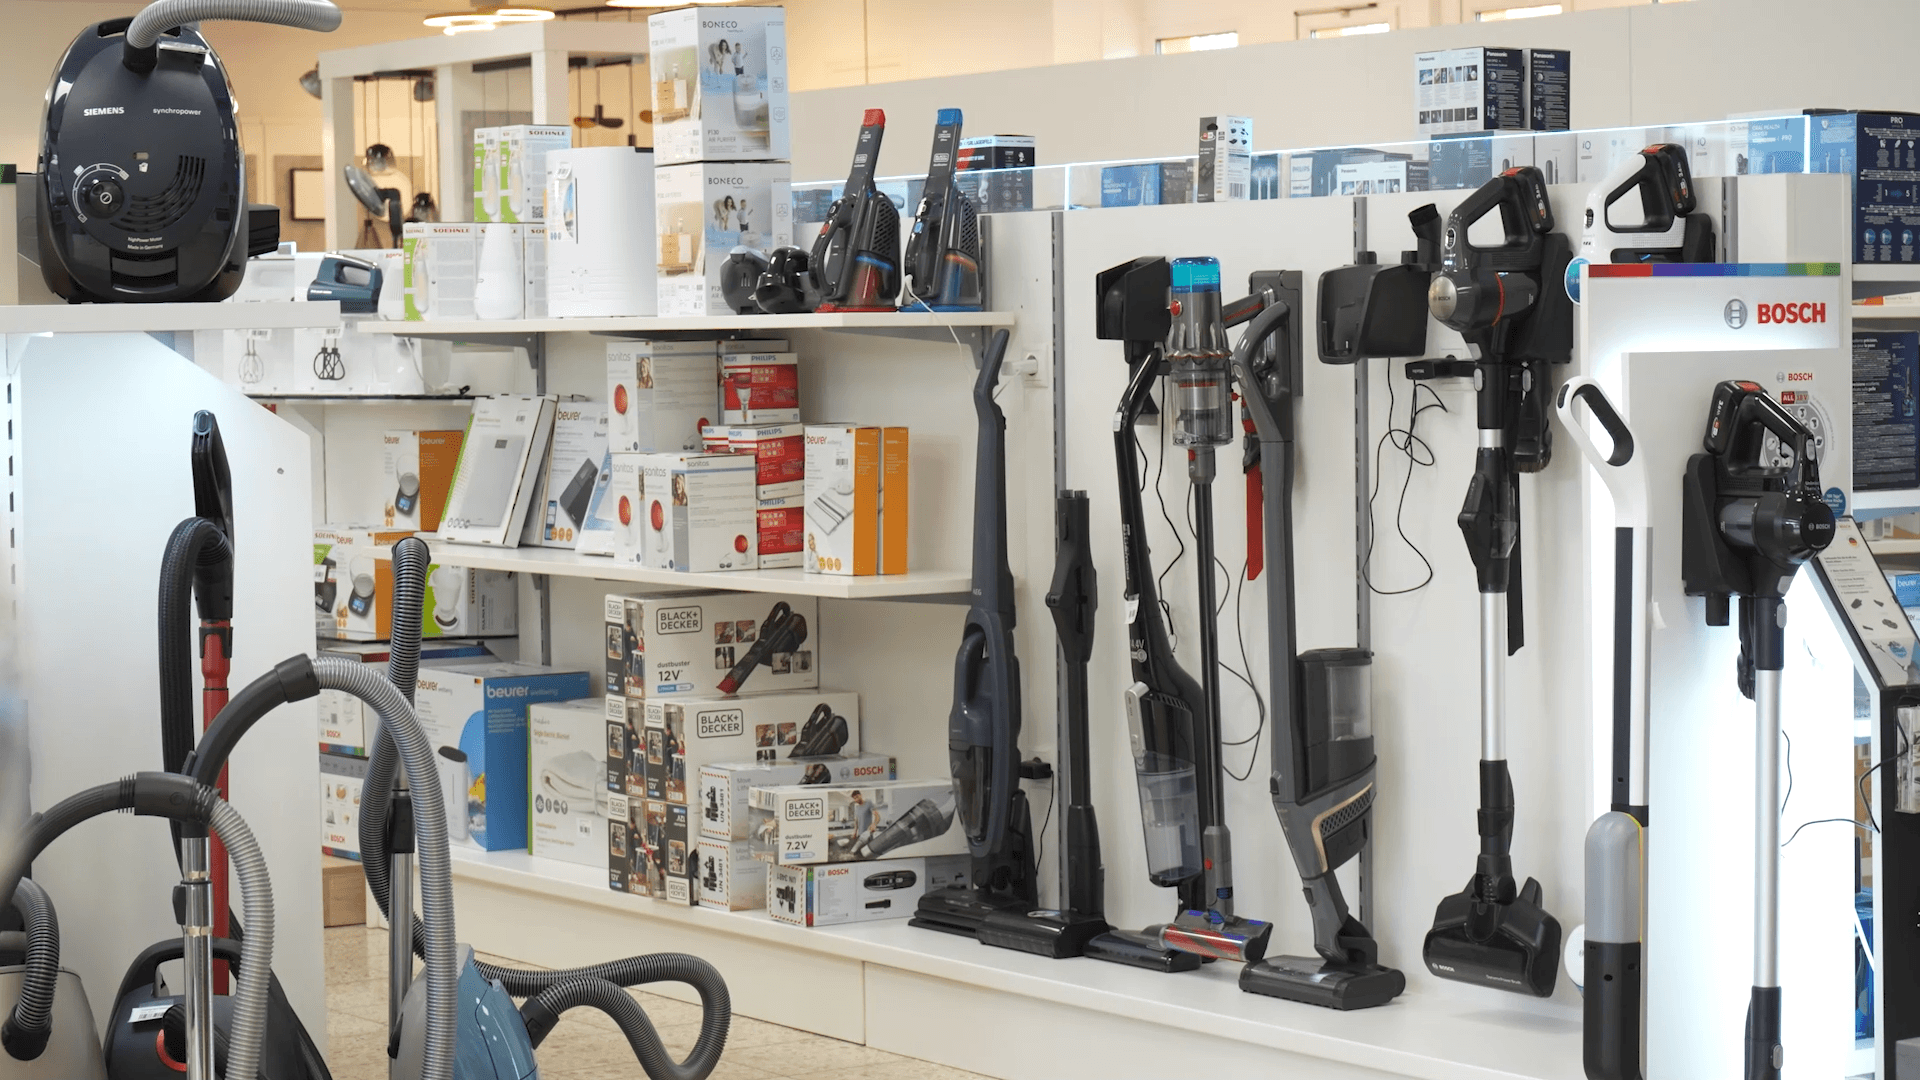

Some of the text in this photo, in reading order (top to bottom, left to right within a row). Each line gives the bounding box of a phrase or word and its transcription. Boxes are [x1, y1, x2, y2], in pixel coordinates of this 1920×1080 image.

[84, 106, 124, 116] SIEMENS
[153, 108, 202, 116] synchropower
[1890, 116, 1903, 124] PRO
[1757, 302, 1826, 324] BOSCH
[608, 351, 631, 361] sanitas
[1788, 372, 1813, 381] BOSCH
[558, 409, 581, 421] beurer
[757, 428, 782, 436] PHILIPS
[384, 435, 400, 445] beurer
[806, 433, 827, 444] beurer
[613, 464, 634, 473] sanitas
[644, 467, 666, 477] sanitas
[337, 535, 353, 544] beurer
[973, 588, 982, 596] AEG
[660, 611, 698, 620] BLACK+
[661, 620, 699, 630] DECKER
[417, 679, 438, 691] beurer
[486, 686, 529, 698] beurer
[701, 714, 738, 724] BLACK+
[701, 724, 740, 733] DECKER
[326, 730, 341, 738] BOSCH
[854, 766, 884, 776] BOSCH
[788, 802, 819, 810] BLACK+
[720, 813, 725, 822] UN
[789, 809, 820, 817] DECKER
[331, 834, 345, 843] BOSCH
[786, 840, 808, 850] 7.2V
[827, 868, 849, 876] BOSCH
[776, 873, 796, 884] UN 3481
[719, 881, 723, 892] UN
[1439, 964, 1455, 972] BOSCH
